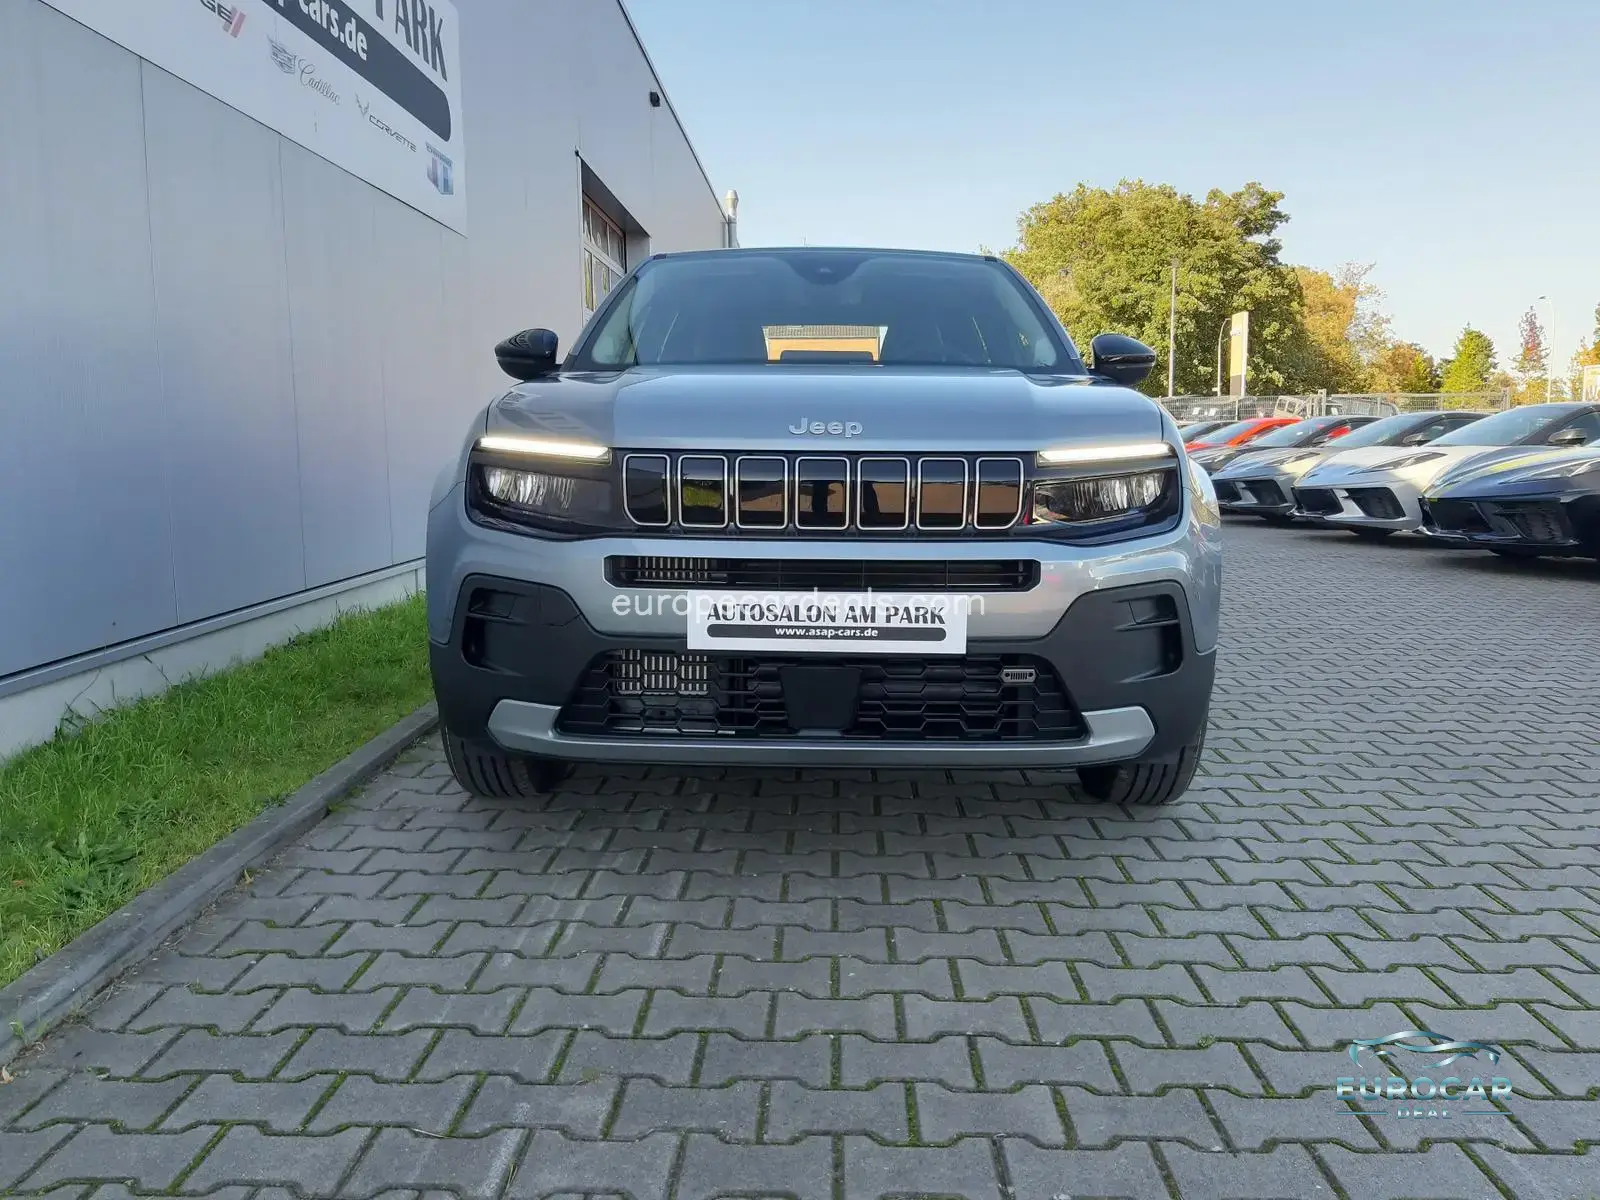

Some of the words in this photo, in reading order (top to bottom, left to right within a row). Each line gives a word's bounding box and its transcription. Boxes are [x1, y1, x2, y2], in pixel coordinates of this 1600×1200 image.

[369, 114, 417, 153] CORVETTE
[788, 417, 863, 438] Jeep
[706, 603, 837, 623] AUTOSALON
[844, 604, 877, 624] AM
[884, 606, 946, 625] PARK
[774, 626, 879, 639] www.asap-cars.de
